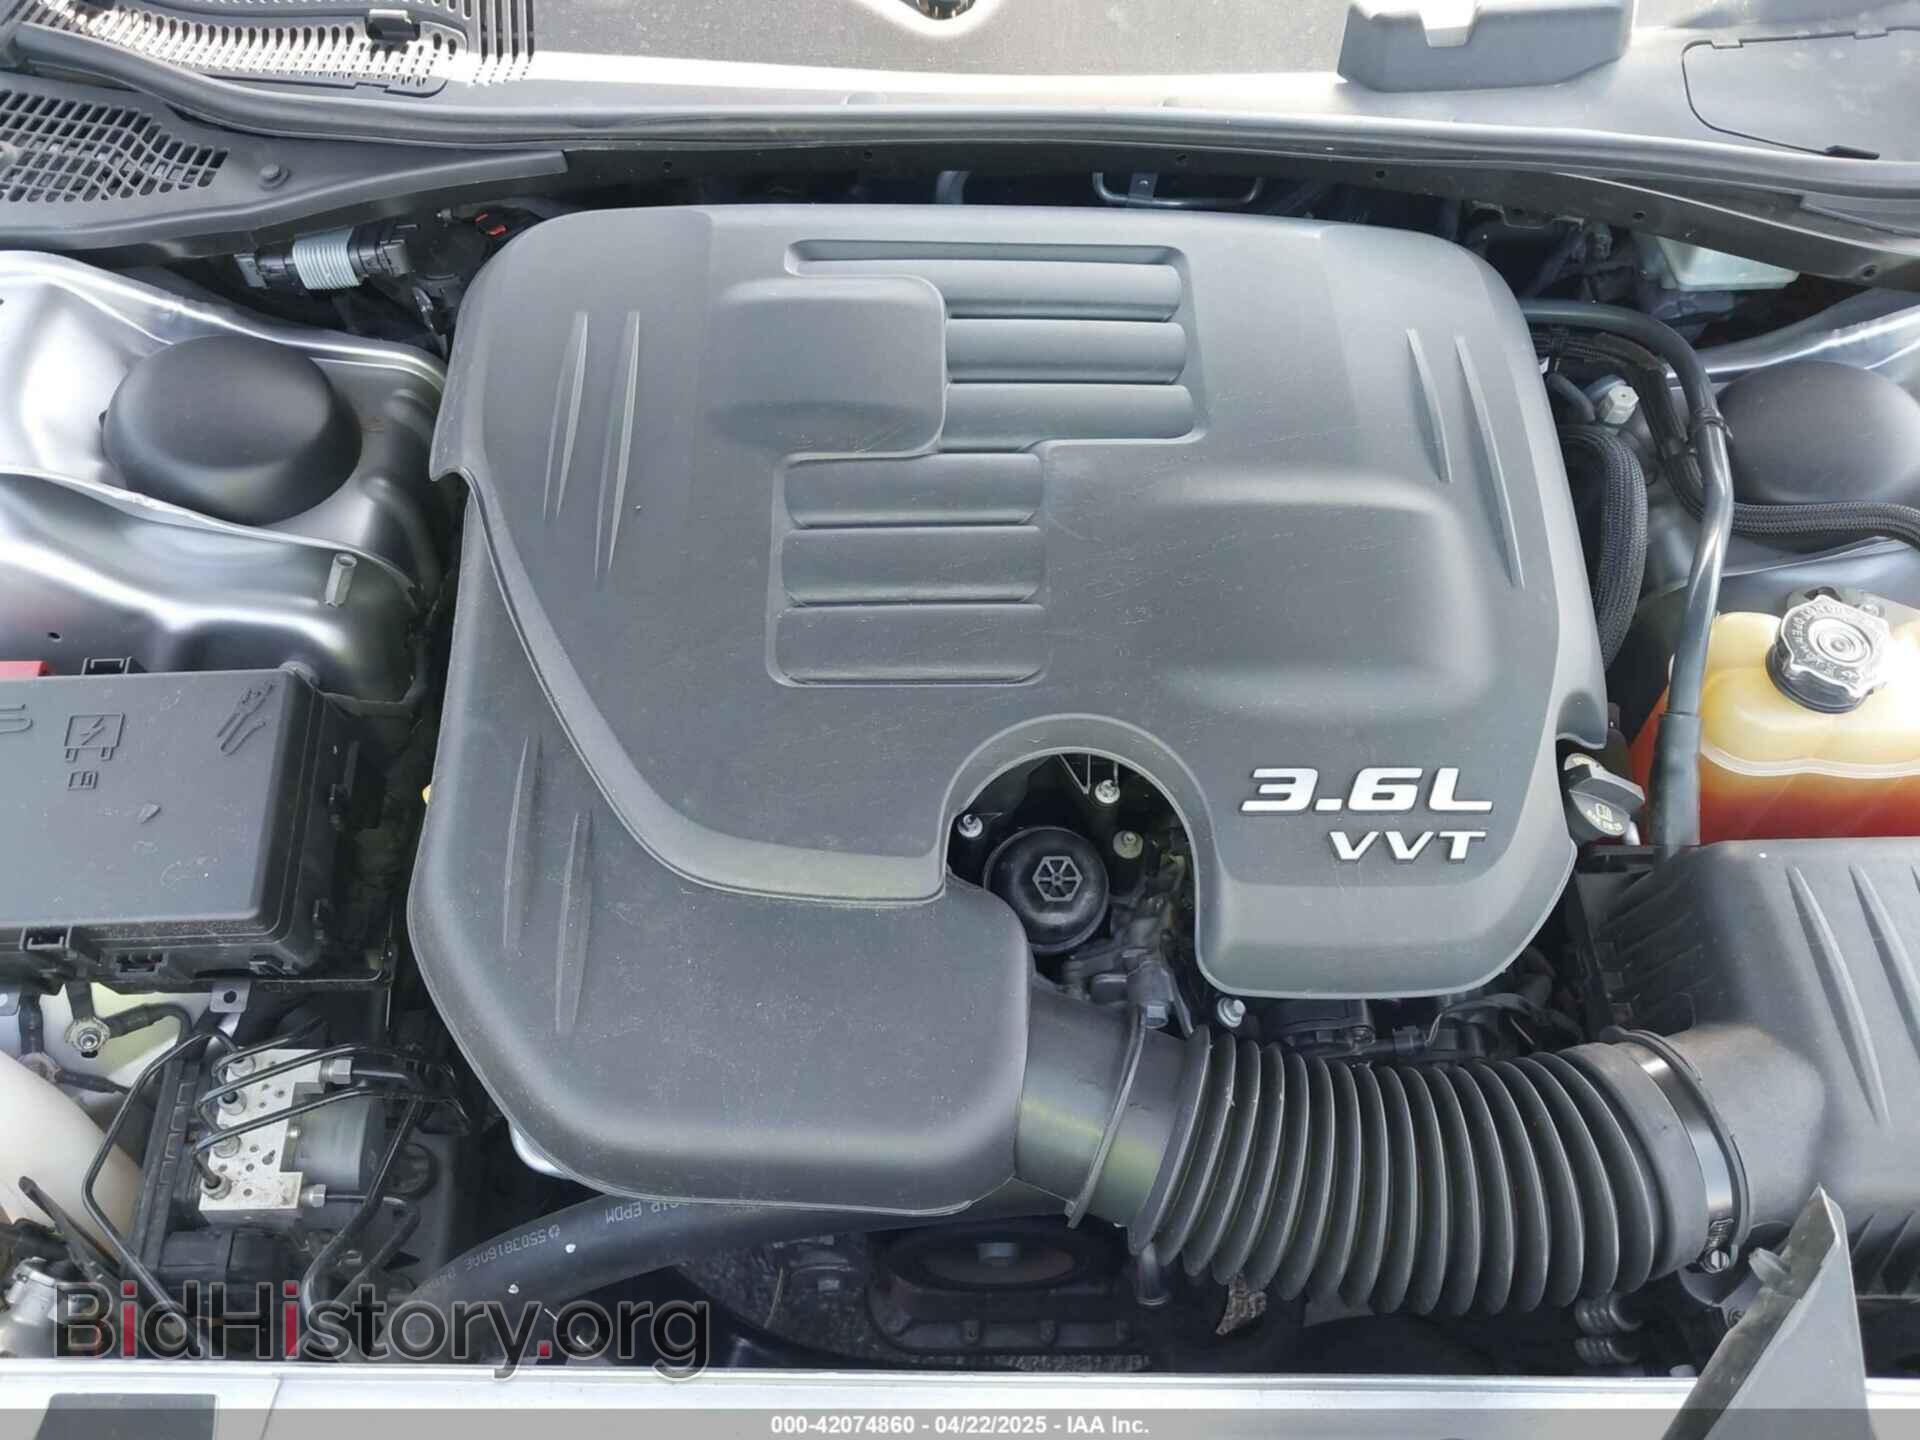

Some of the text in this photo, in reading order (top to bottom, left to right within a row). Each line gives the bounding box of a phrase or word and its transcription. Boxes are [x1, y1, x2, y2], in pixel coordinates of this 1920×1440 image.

[1240, 767, 1494, 814] 3.6L
[1328, 831, 1487, 862] VVT
[605, 1203, 643, 1225] EPDM
